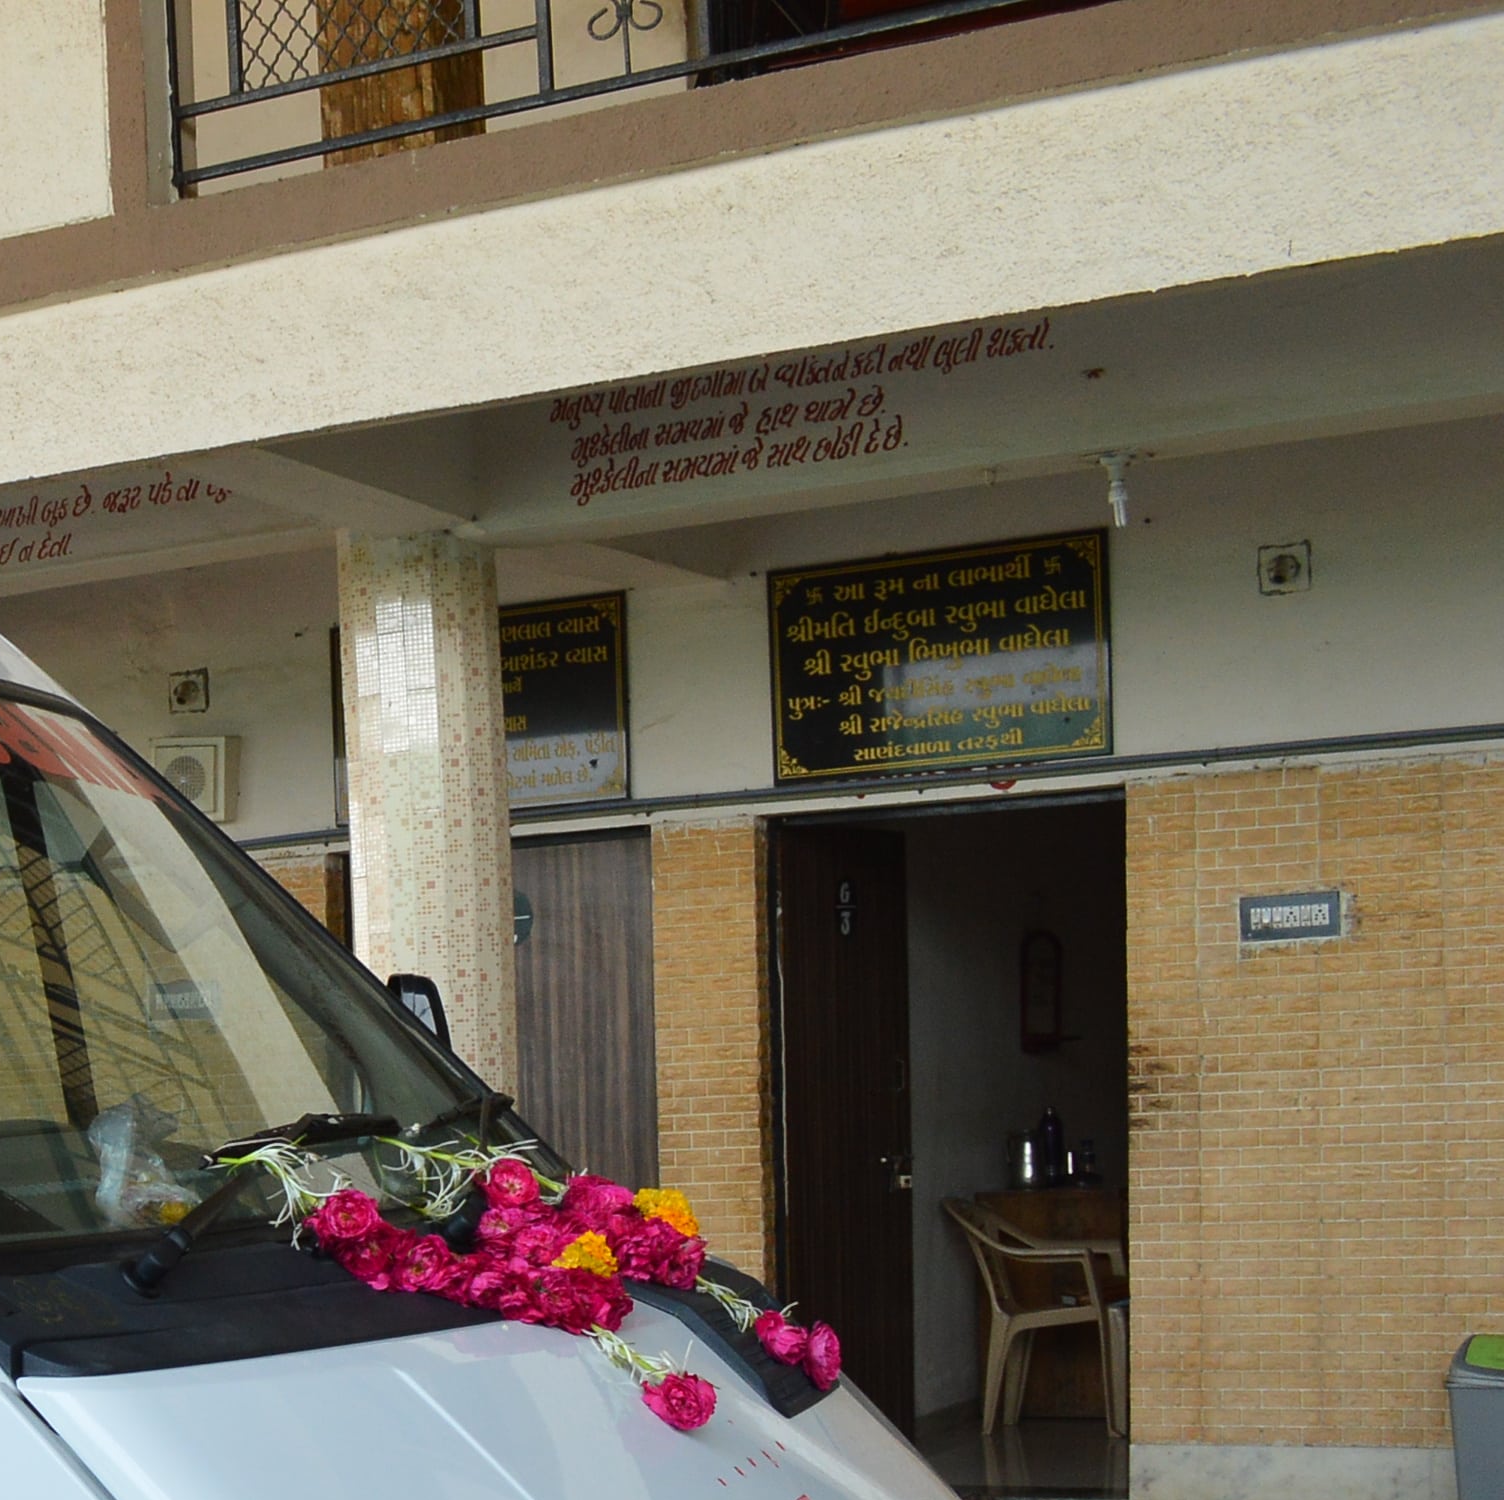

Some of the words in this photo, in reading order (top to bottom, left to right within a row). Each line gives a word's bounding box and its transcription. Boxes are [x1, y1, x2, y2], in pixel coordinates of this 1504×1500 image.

[833, 583, 865, 601] આ
[873, 577, 905, 601] રૂમ
[912, 572, 940, 591] ના
[944, 599, 1007, 633] રવુભા
[1013, 585, 1088, 615] વાઘેલા
[557, 615, 600, 635] વ્યાસ
[565, 646, 609, 664] વ્યાસ
[803, 648, 833, 677] શ્રી
[840, 648, 900, 681] રવુભા
[998, 623, 1072, 653] વાઘેલા
[838, 684, 863, 706] શ્રી
[839, 713, 863, 735] શ્રી
[972, 702, 1025, 730] રવુભા
[1031, 690, 1091, 715] વાઘેલા
[957, 727, 1024, 750] તરફથી
